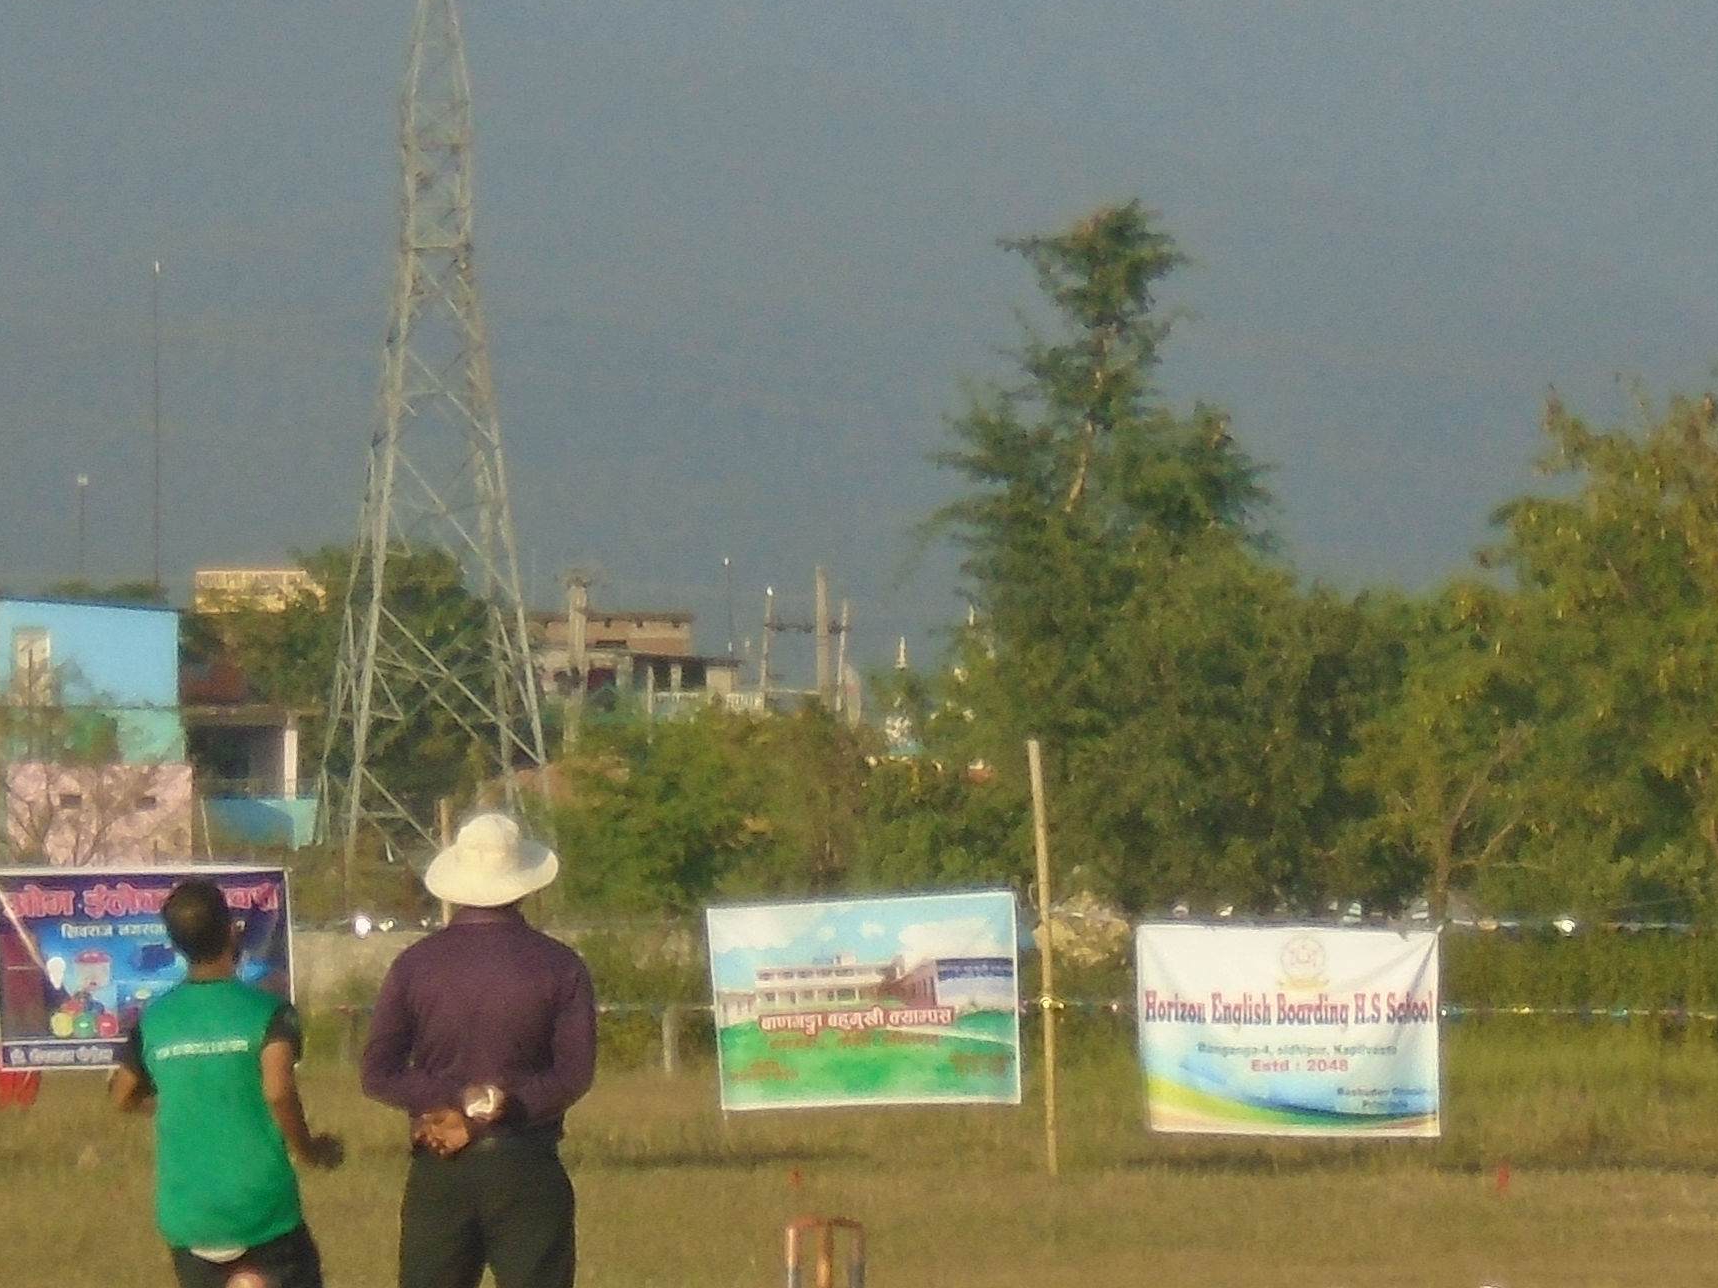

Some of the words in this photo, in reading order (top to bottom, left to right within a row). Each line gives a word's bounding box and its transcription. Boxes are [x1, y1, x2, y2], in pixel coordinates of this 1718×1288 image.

[1145, 990, 1206, 1023] Horizon
[1211, 991, 1272, 1033] English
[1276, 991, 1350, 1033] Boarding
[1386, 990, 1435, 1024] School
[1306, 1058, 1350, 1072] 2048
